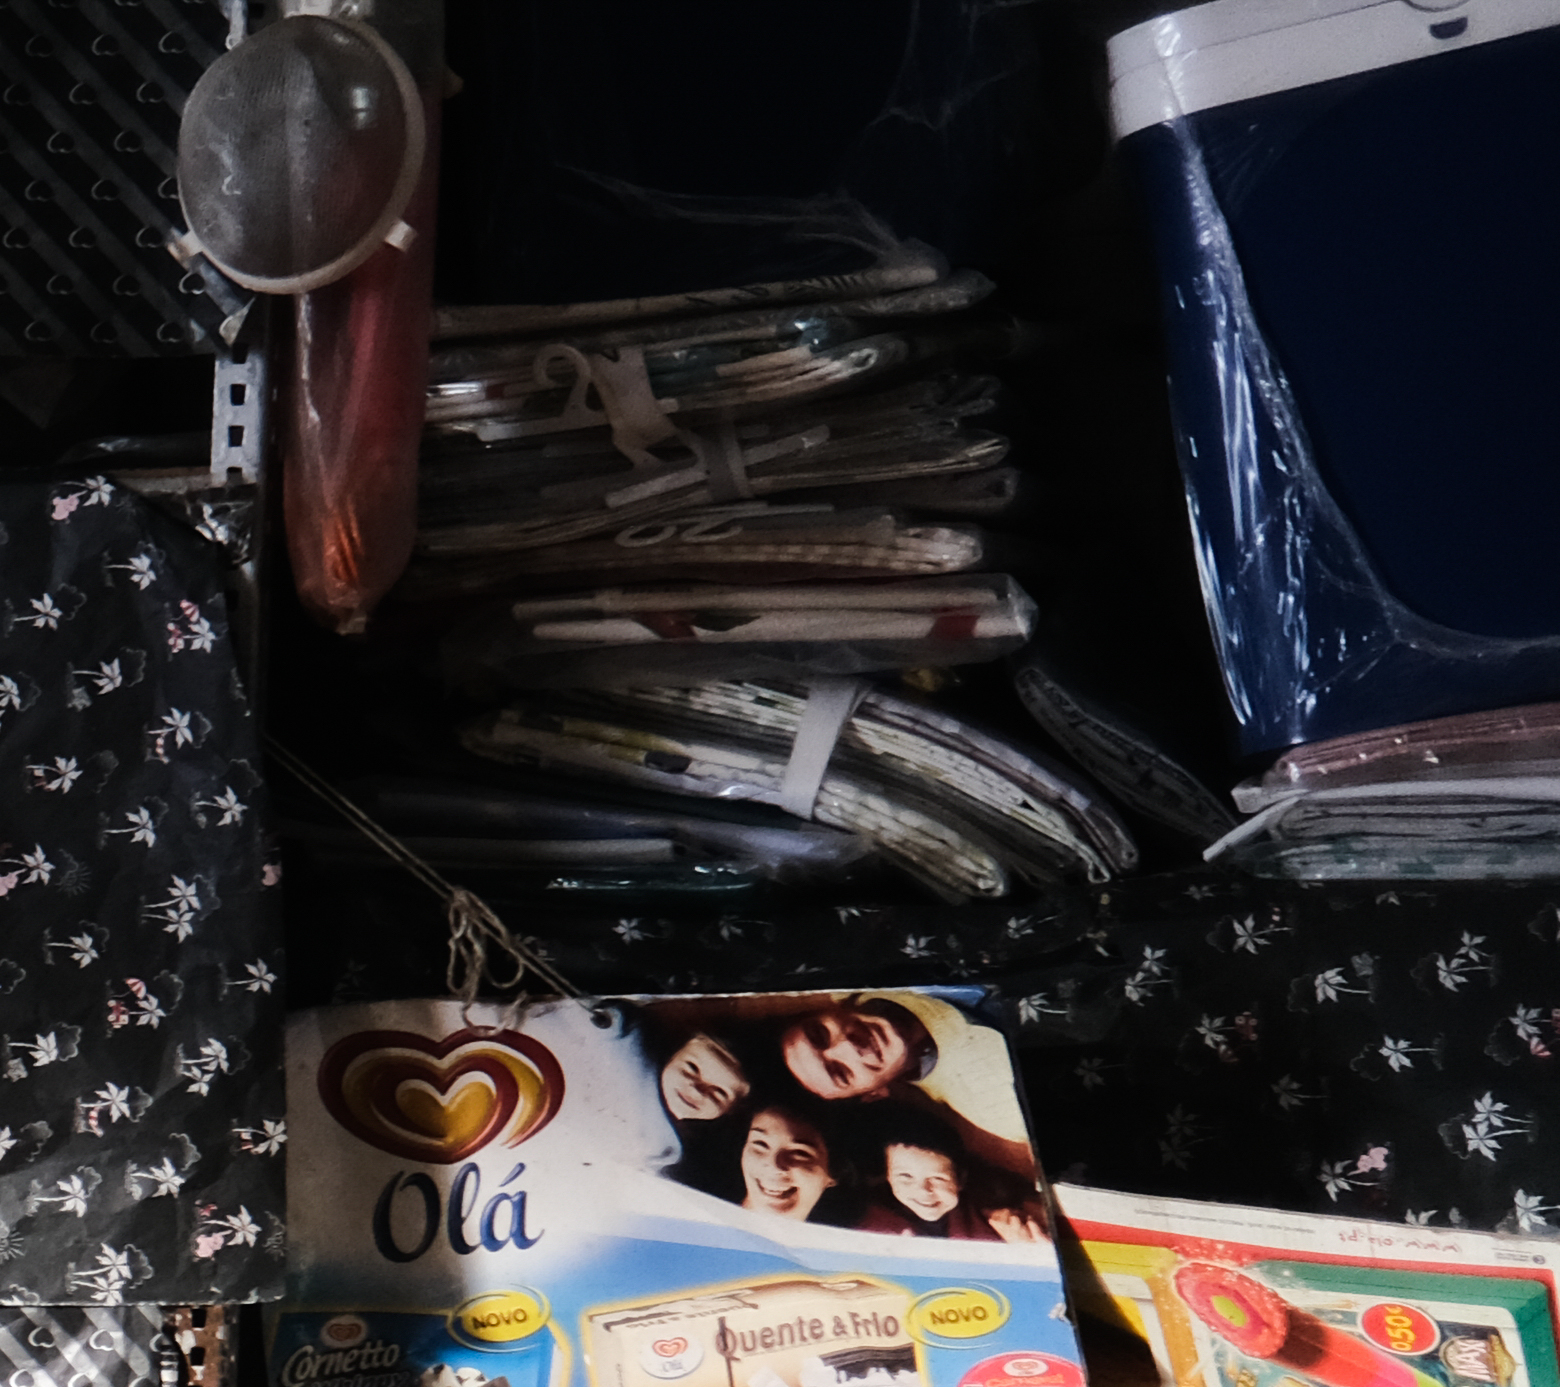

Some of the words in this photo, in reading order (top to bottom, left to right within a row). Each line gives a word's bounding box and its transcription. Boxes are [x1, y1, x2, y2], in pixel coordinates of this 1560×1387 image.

[373, 1162, 545, 1263] Olá
[473, 1308, 528, 1329] NOVO
[930, 1306, 989, 1326] NOVO
[716, 1314, 824, 1362] Quente
[832, 1319, 847, 1338] &
